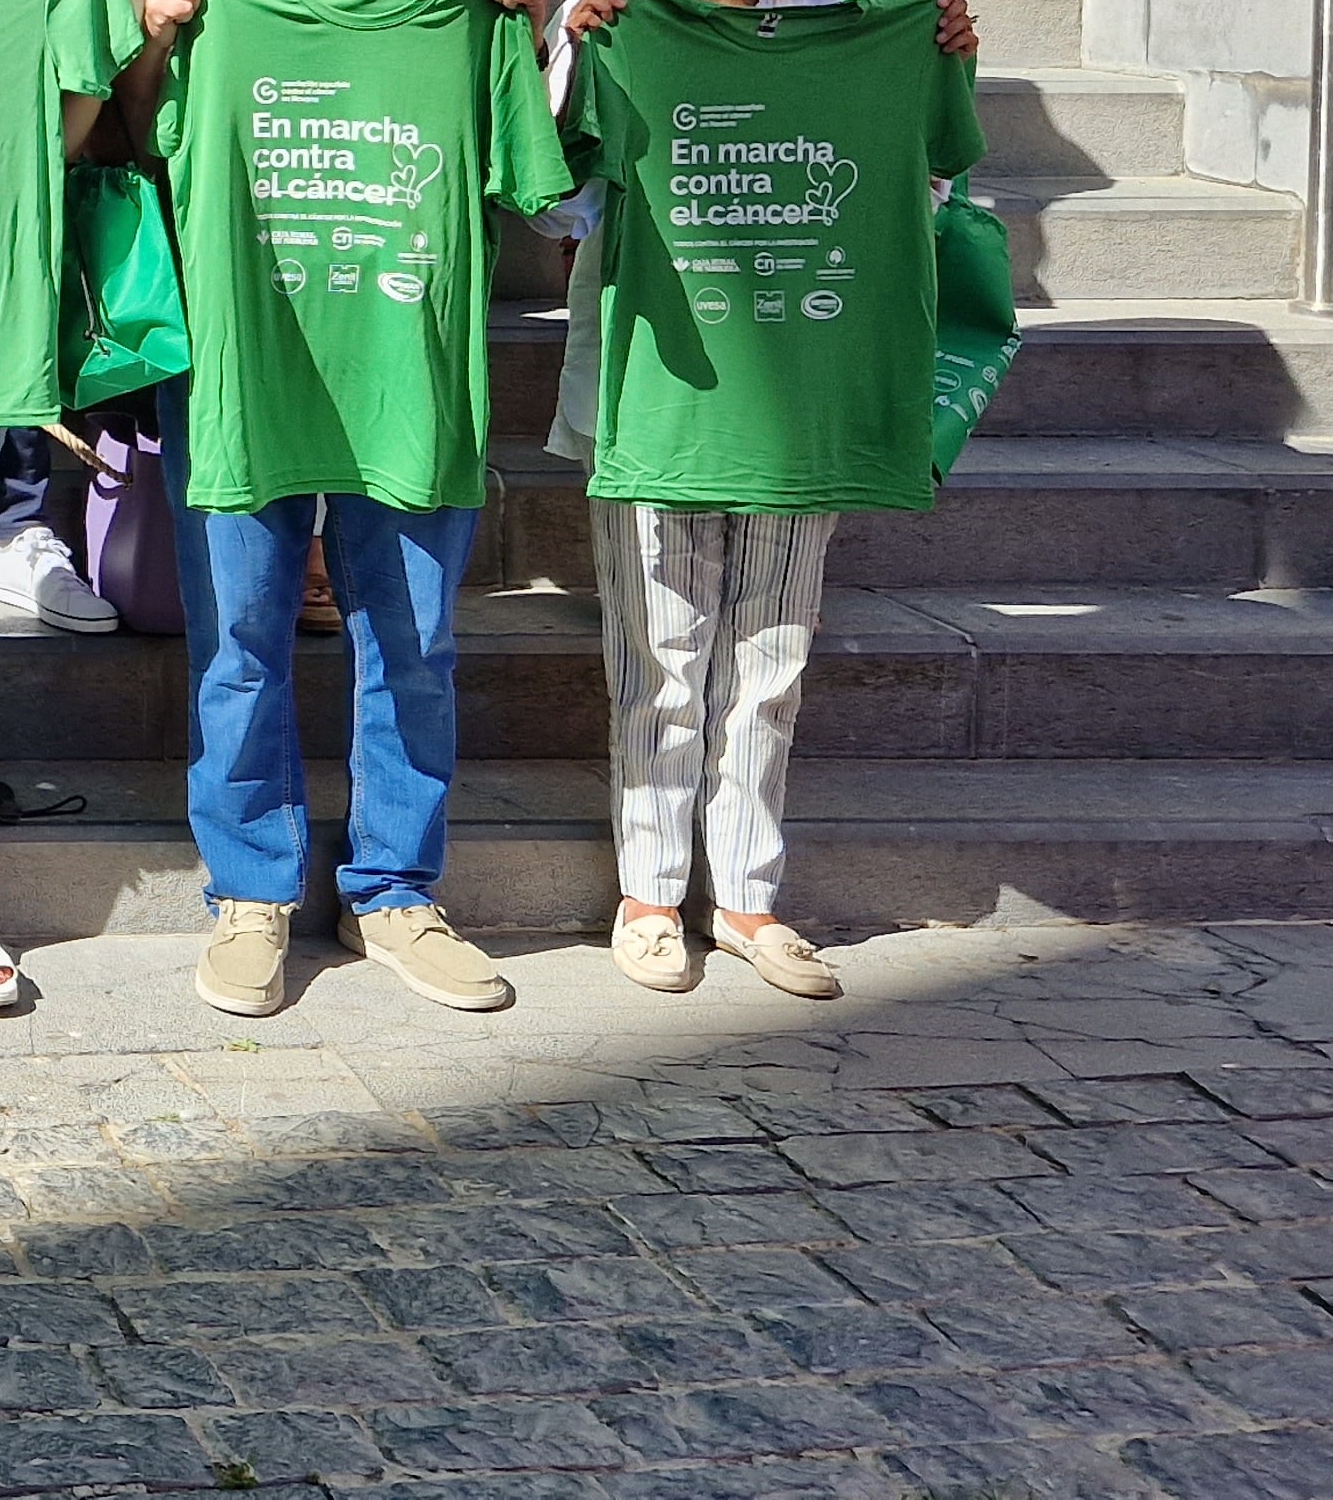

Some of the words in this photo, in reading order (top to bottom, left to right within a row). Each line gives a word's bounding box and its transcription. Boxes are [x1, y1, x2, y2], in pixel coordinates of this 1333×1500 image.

[252, 111, 291, 139] En
[299, 116, 419, 145] marcha
[253, 143, 355, 171] contra
[671, 137, 710, 165] En
[718, 135, 834, 164] marcha
[253, 171, 280, 199] el
[287, 172, 399, 206] cáncer
[669, 168, 773, 196] contra
[669, 199, 700, 226] el
[707, 198, 814, 226] cáncer
